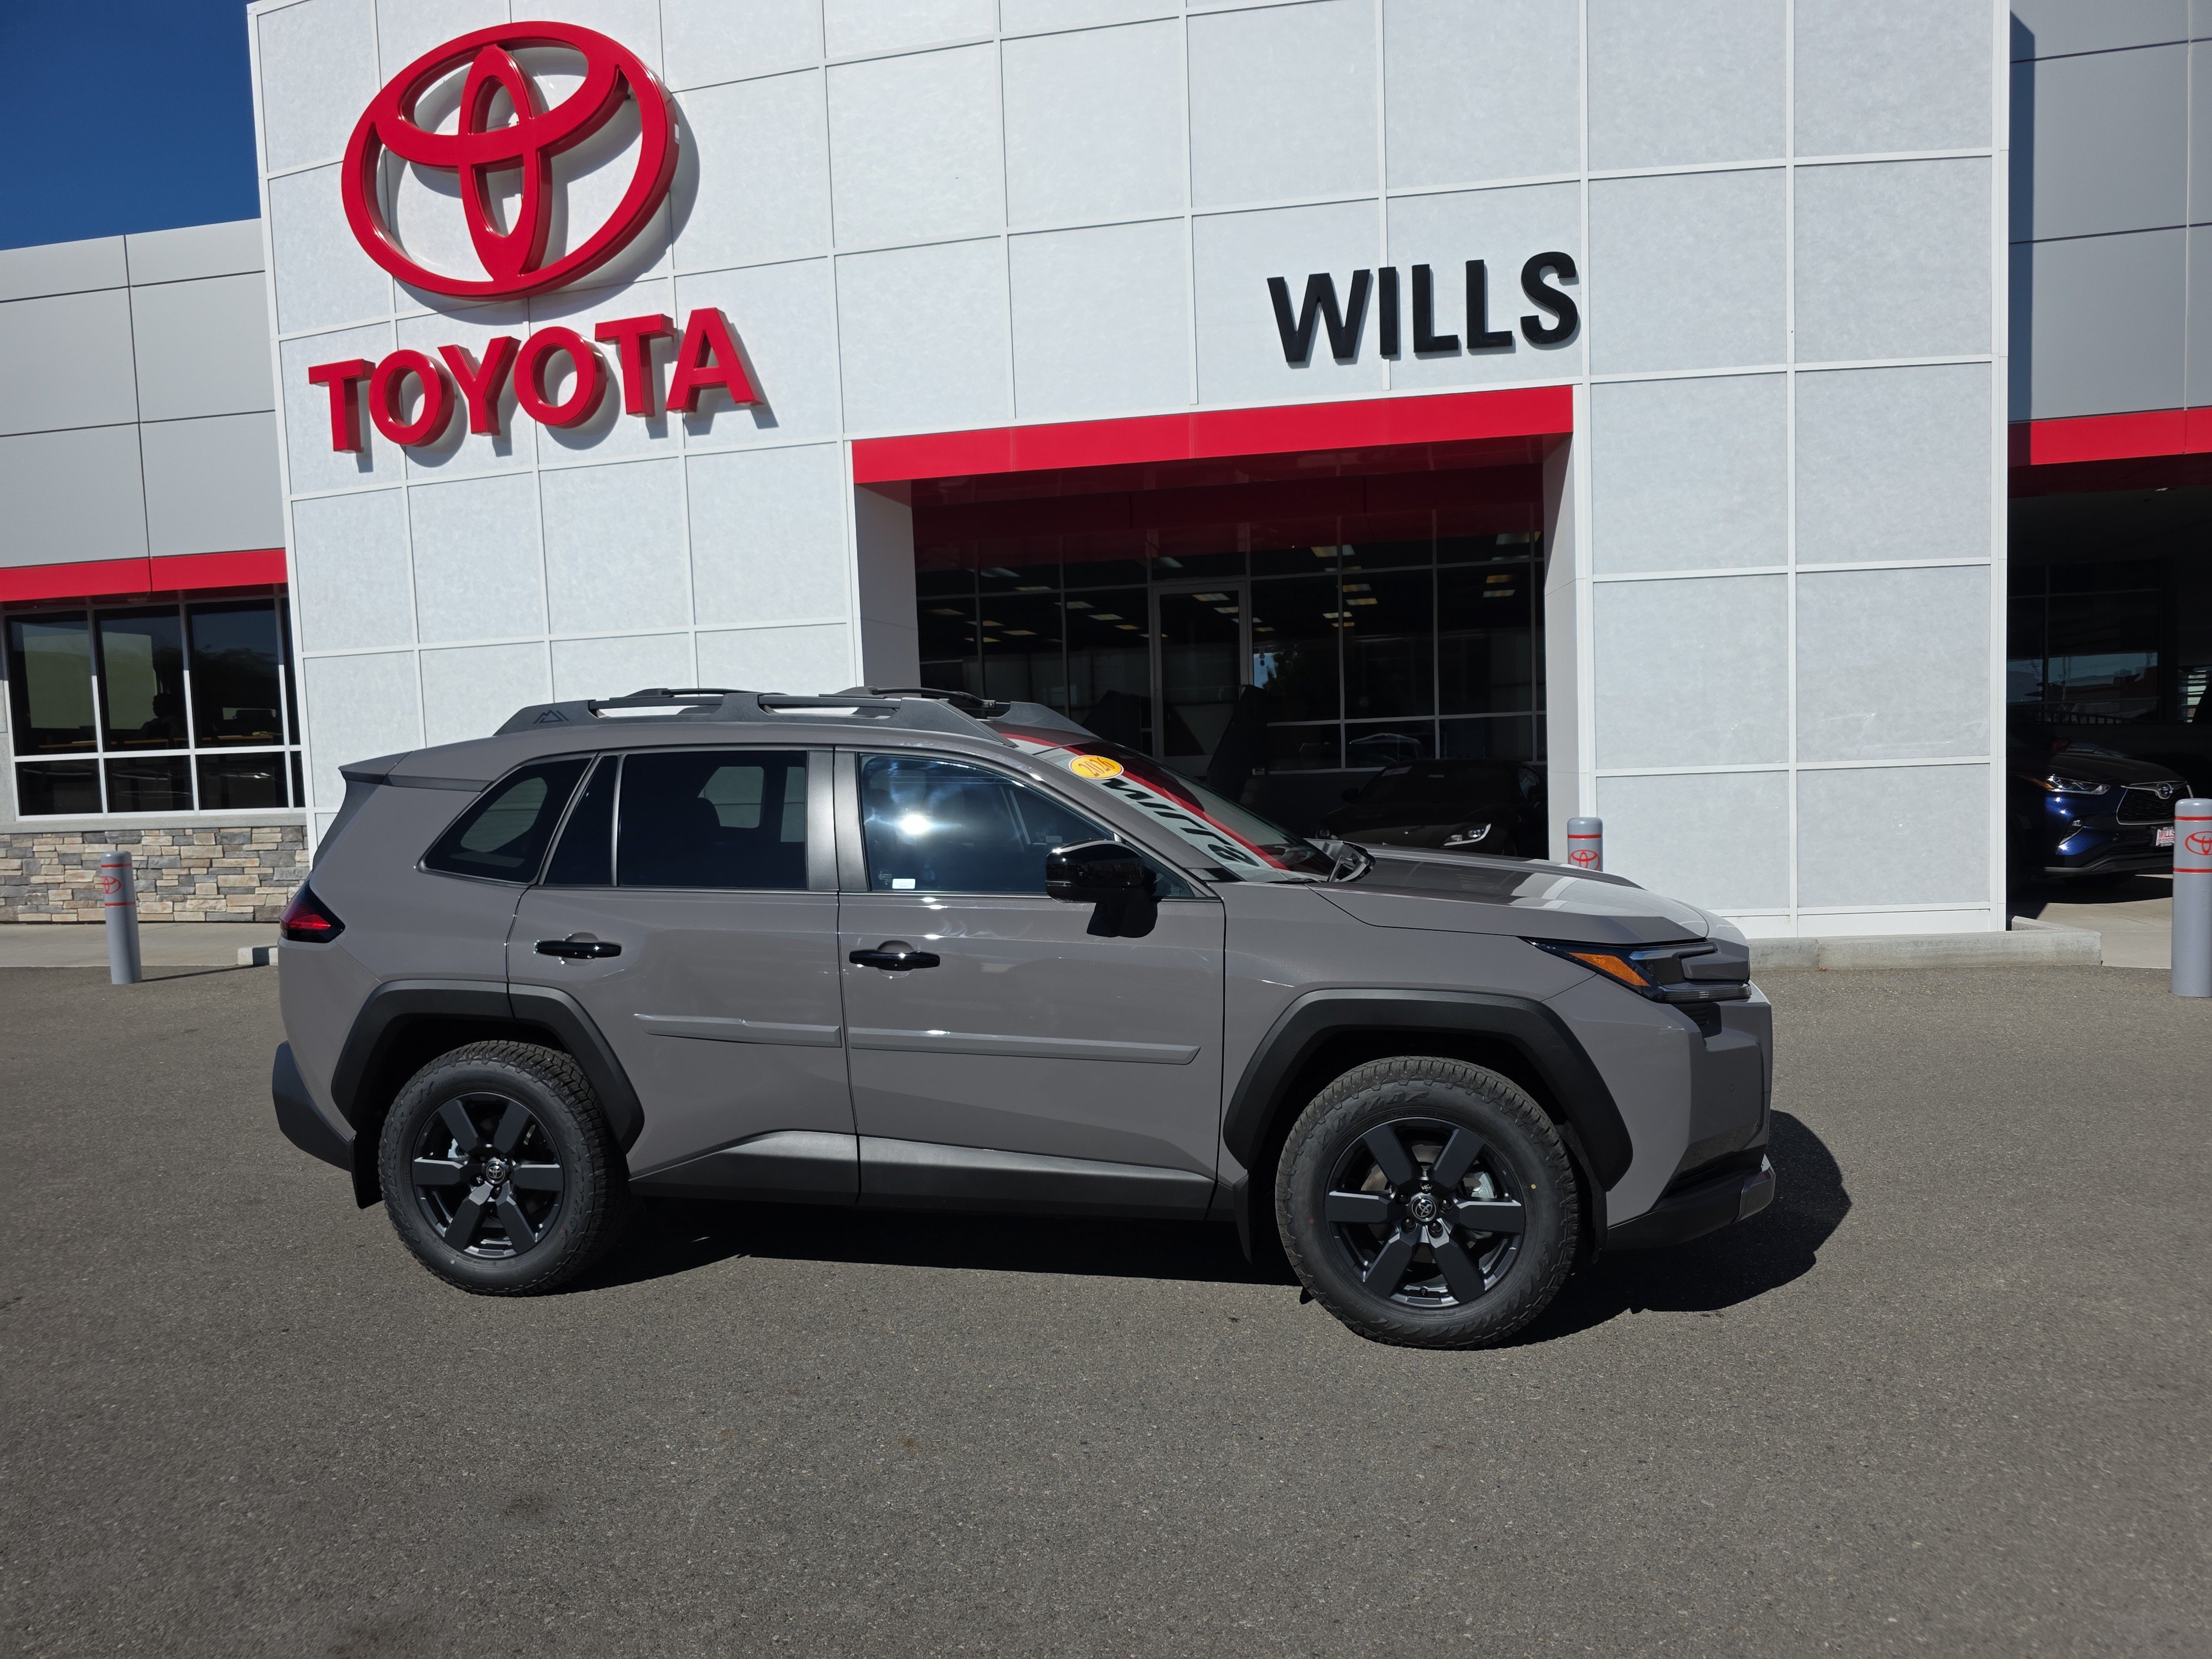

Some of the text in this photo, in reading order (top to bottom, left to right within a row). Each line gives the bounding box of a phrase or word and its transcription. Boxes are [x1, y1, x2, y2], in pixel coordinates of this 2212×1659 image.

[1266, 251, 1578, 363] WILLS
[308, 307, 764, 454] TOYOTA
[1078, 757, 1115, 777] 2026
[2159, 830, 2175, 838] WILLS
[1320, 1090, 1429, 1147] DUNLOP
